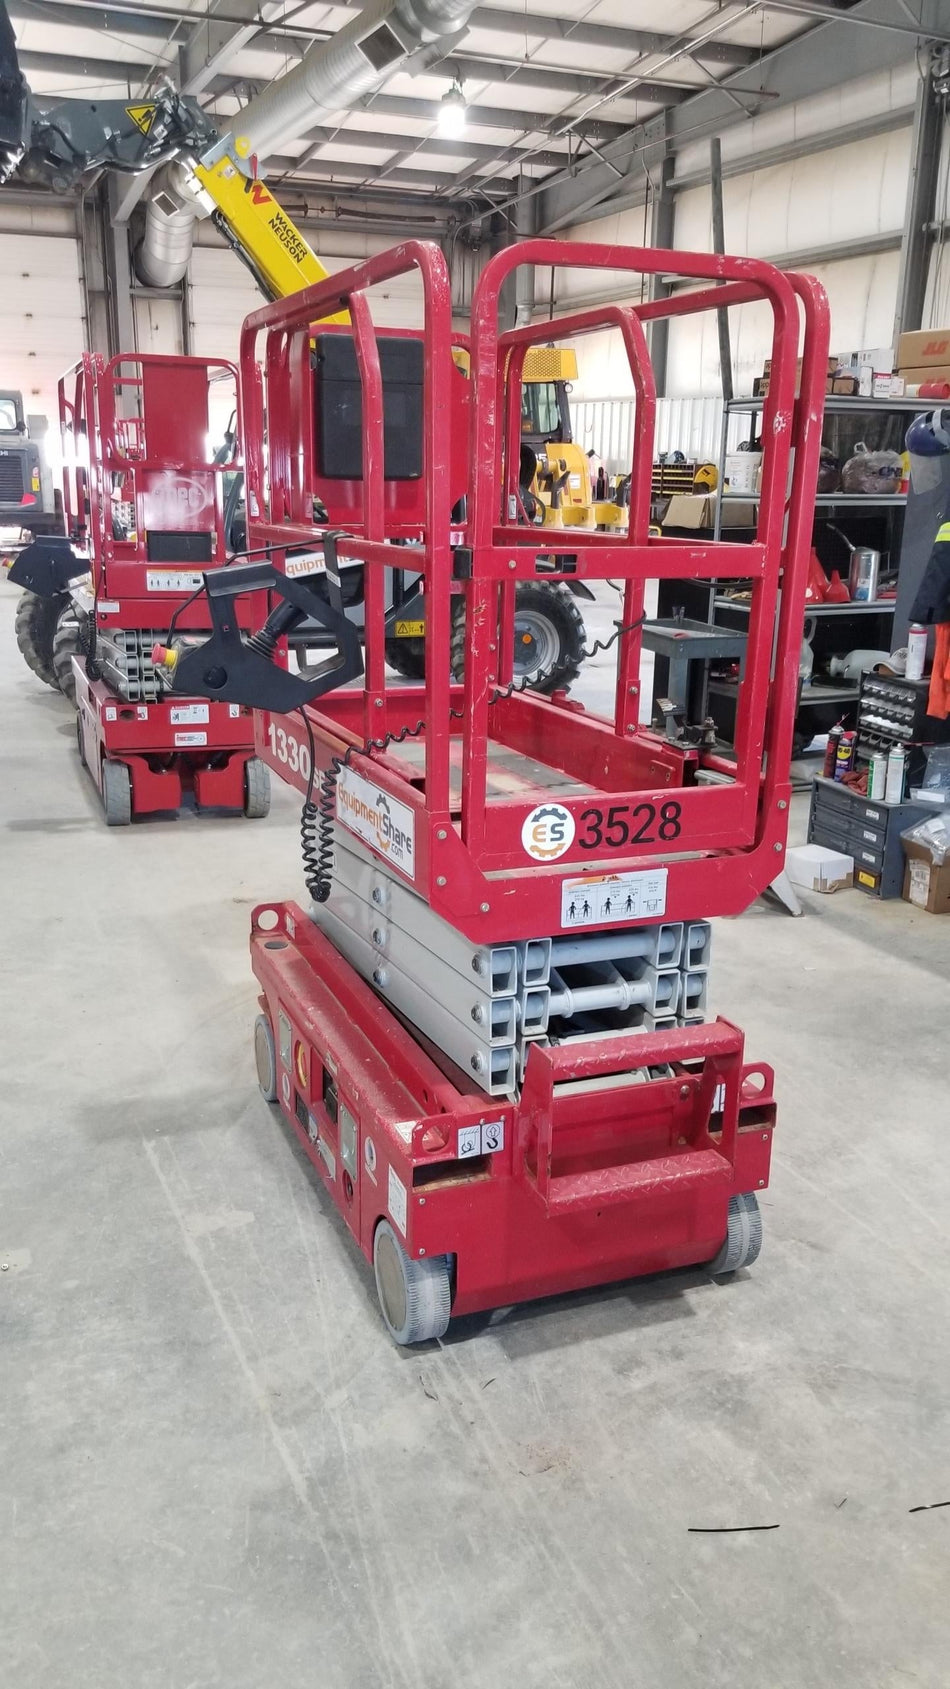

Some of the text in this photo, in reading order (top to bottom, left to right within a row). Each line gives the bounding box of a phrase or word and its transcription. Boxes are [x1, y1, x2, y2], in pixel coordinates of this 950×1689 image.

[268, 218, 303, 264] NEUSON
[275, 212, 308, 258] WACKER
[268, 722, 312, 782] 1330
[339, 783, 412, 855] EquipmentShare
[531, 801, 682, 850] ES 3528
